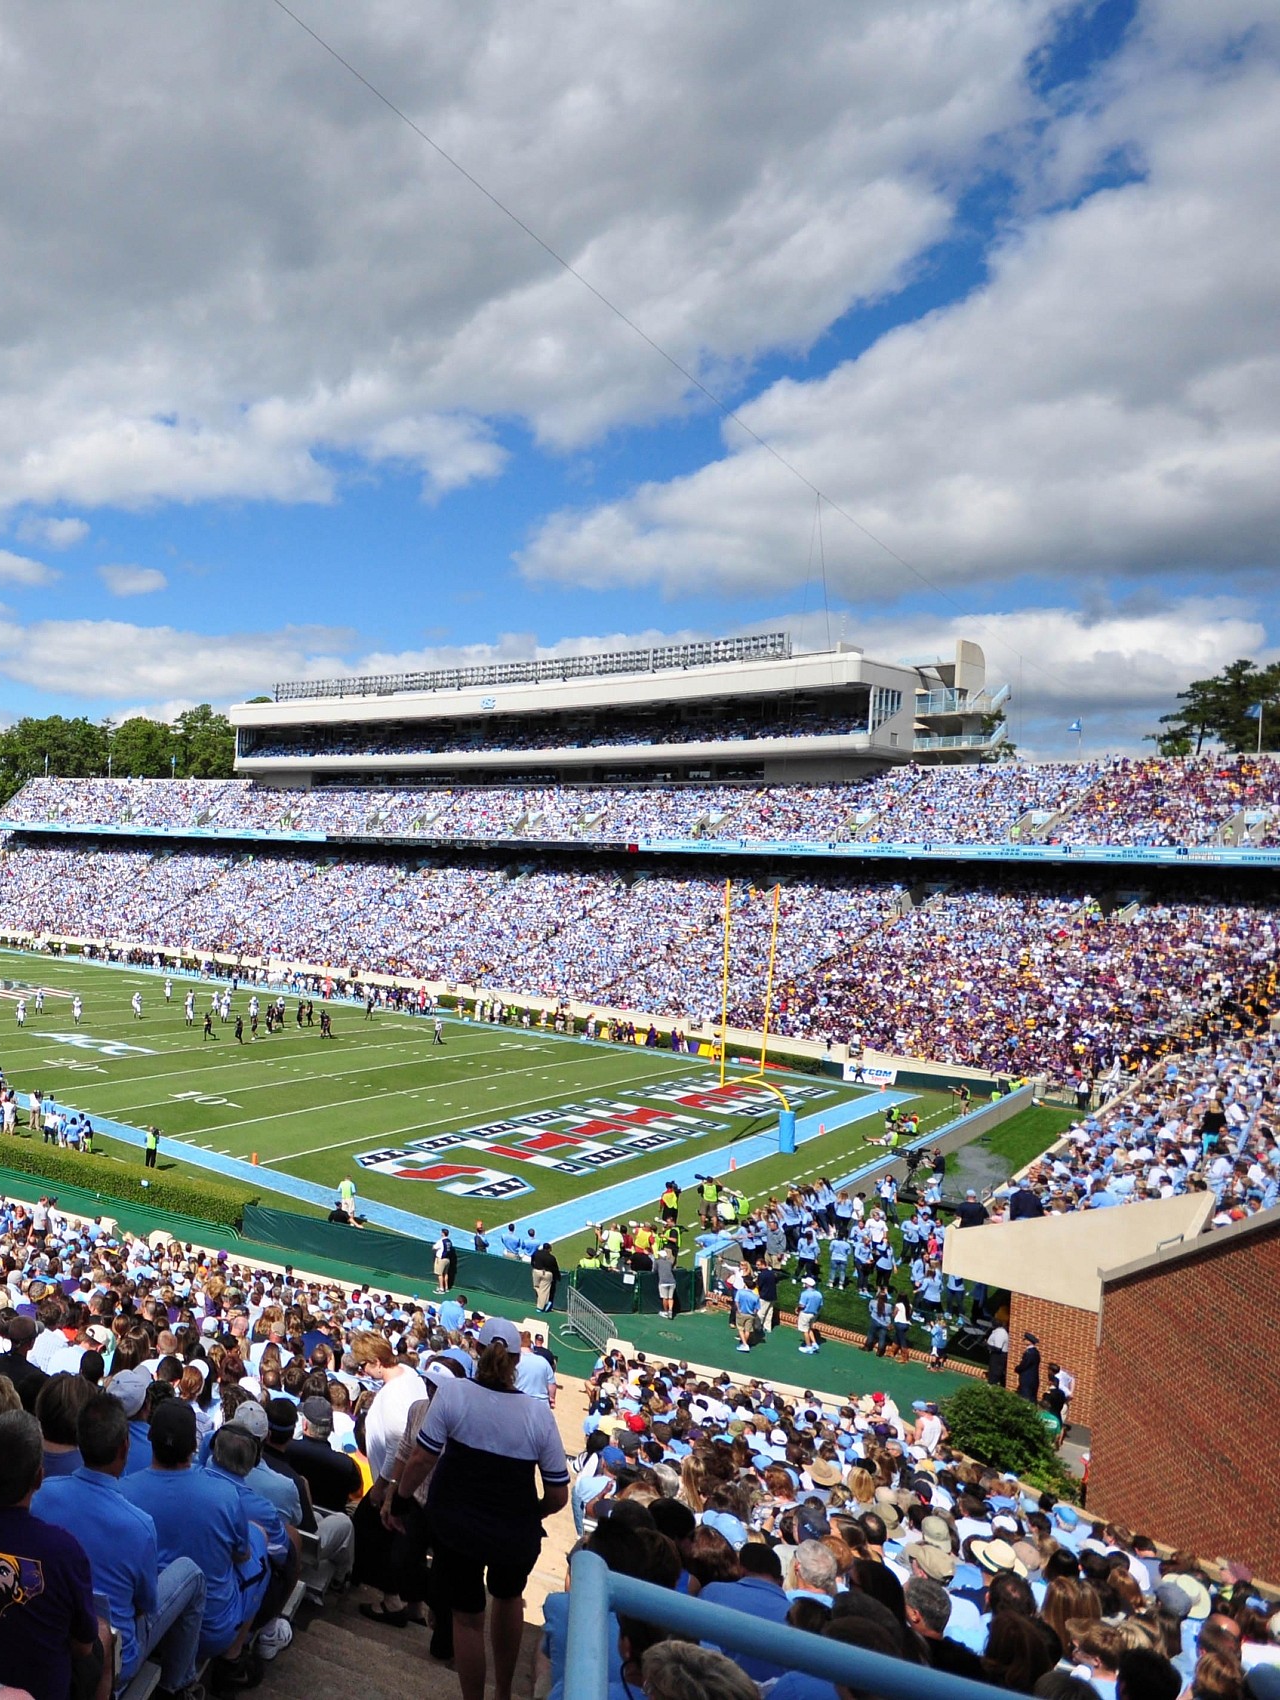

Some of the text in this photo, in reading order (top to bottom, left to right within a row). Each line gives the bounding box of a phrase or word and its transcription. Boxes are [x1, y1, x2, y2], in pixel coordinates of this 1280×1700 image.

[1062, 846, 1072, 854] 31
[1175, 847, 1188, 855] 49
[29, 1031, 159, 1056] ACC
[42, 1058, 100, 1071] 20
[169, 1090, 228, 1106] 10
